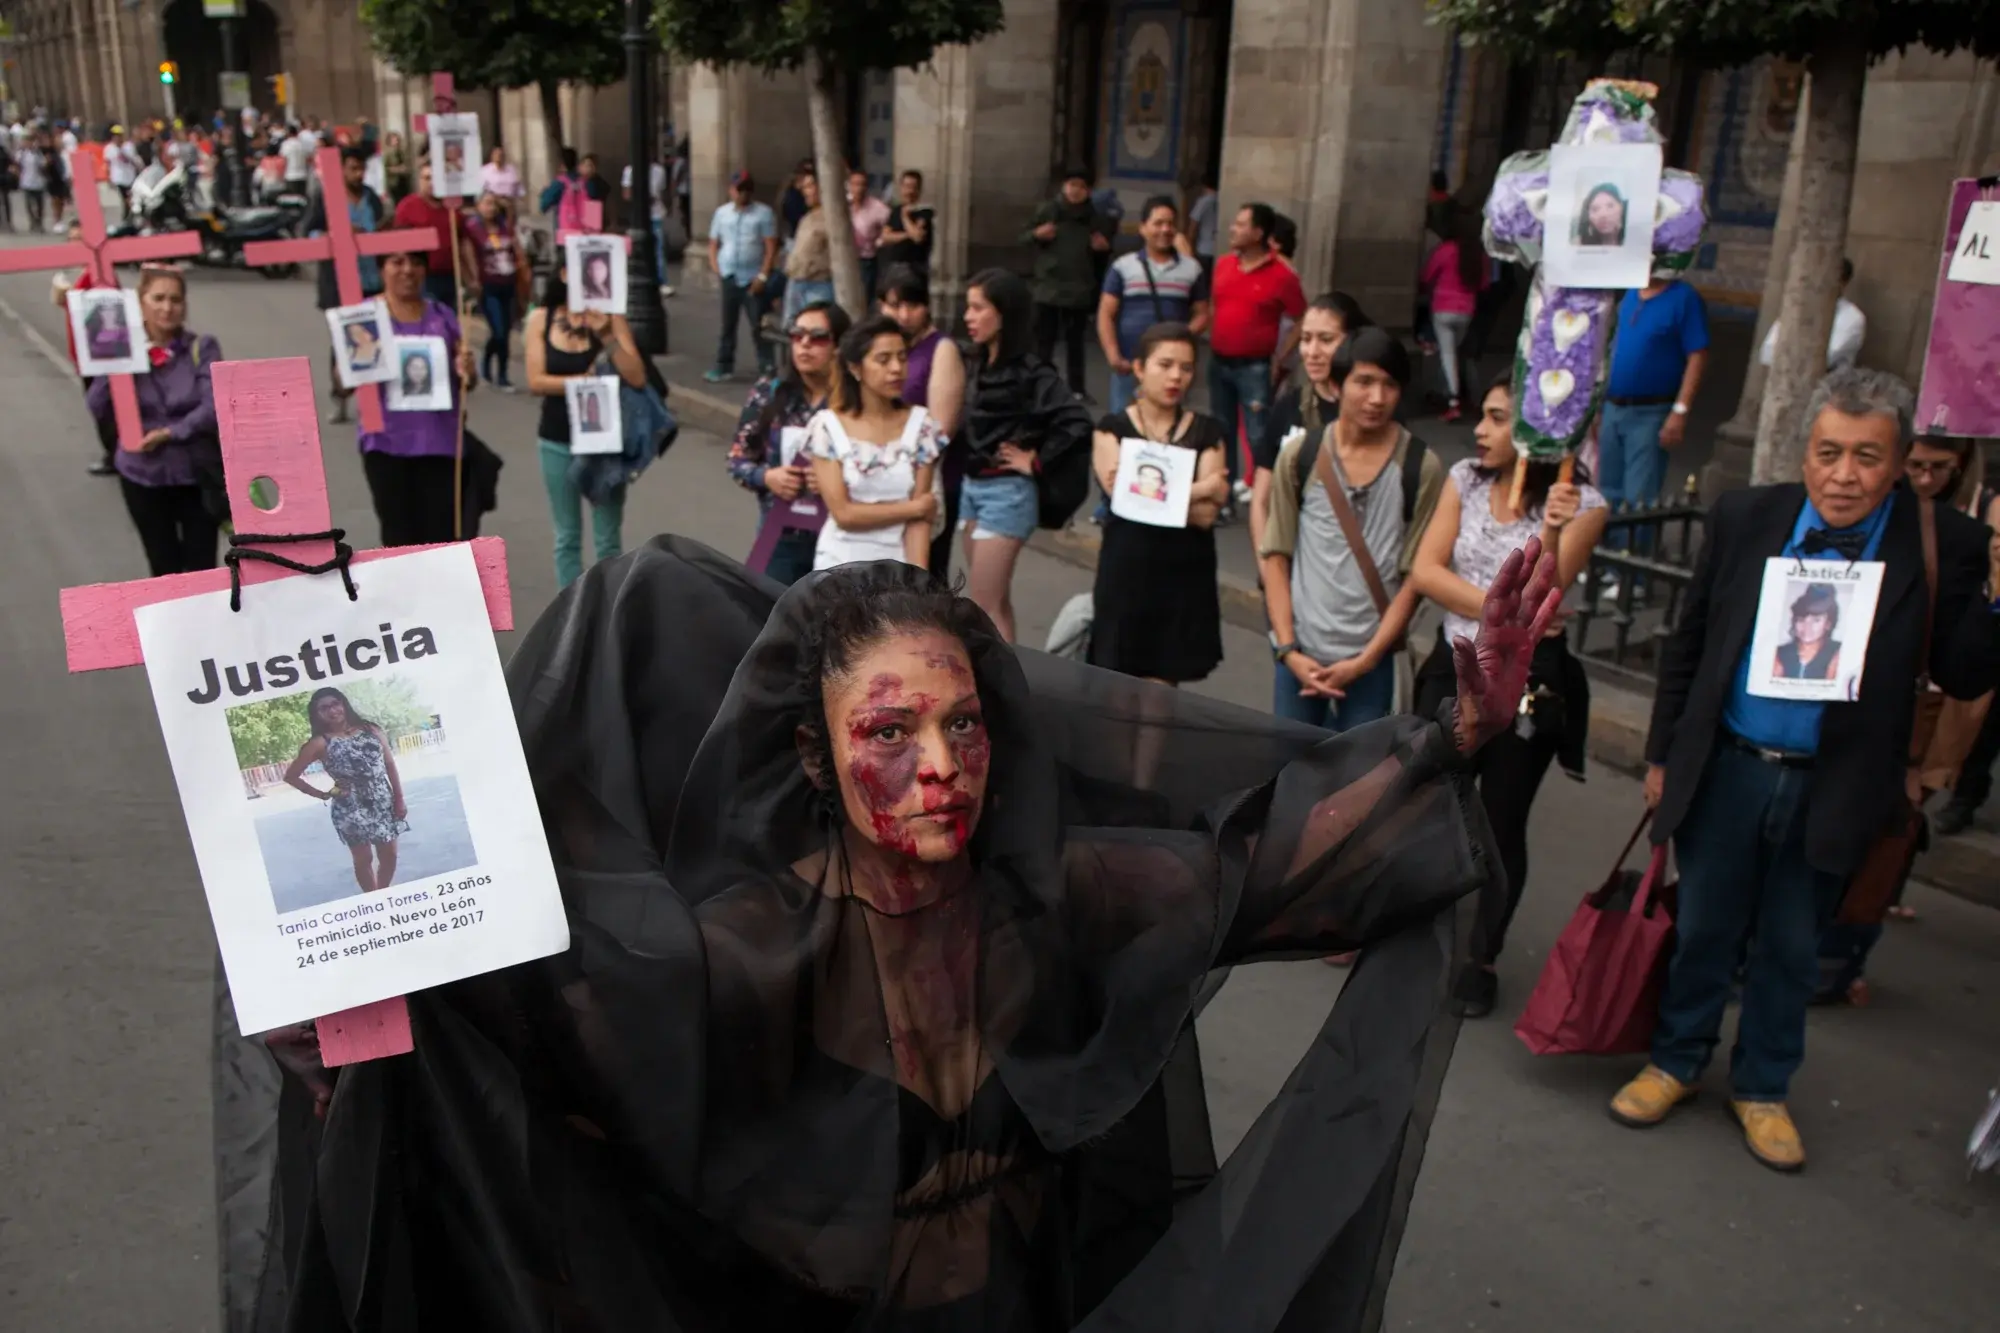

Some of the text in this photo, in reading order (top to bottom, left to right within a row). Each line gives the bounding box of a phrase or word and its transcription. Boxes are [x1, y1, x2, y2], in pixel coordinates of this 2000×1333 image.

[187, 622, 438, 705] Justicia
[277, 875, 492, 936] Tania Carolina Torres, 23 años
[297, 897, 476, 950] Feminicidio. Nuevo León
[297, 910, 484, 968] 24 de septiembre de 2017
